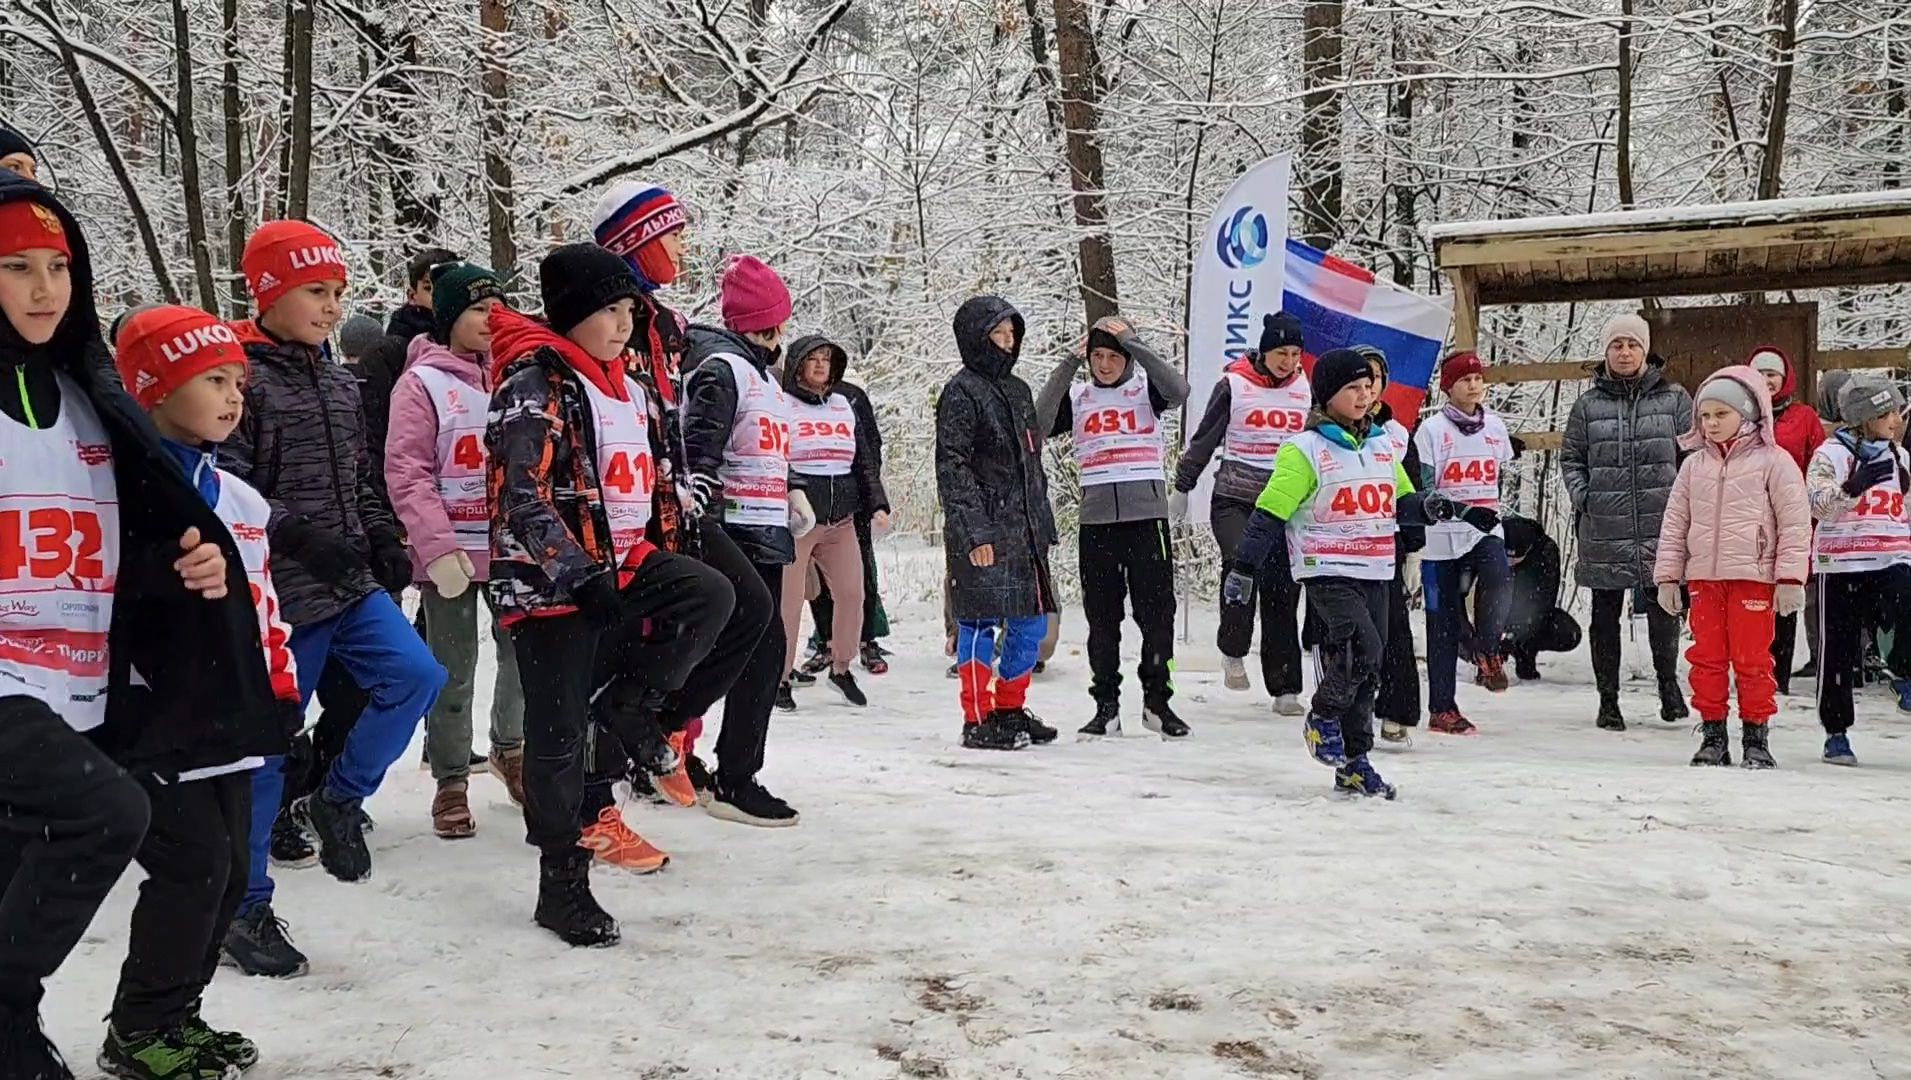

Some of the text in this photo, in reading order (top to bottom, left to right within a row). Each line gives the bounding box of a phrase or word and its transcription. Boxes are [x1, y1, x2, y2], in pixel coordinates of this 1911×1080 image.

[798, 421, 851, 439] 394
[1084, 409, 1136, 434] 431
[1245, 409, 1303, 430] 403
[1444, 459, 1496, 483] 449
[1331, 483, 1394, 515] 402
[0, 508, 103, 580] 432
